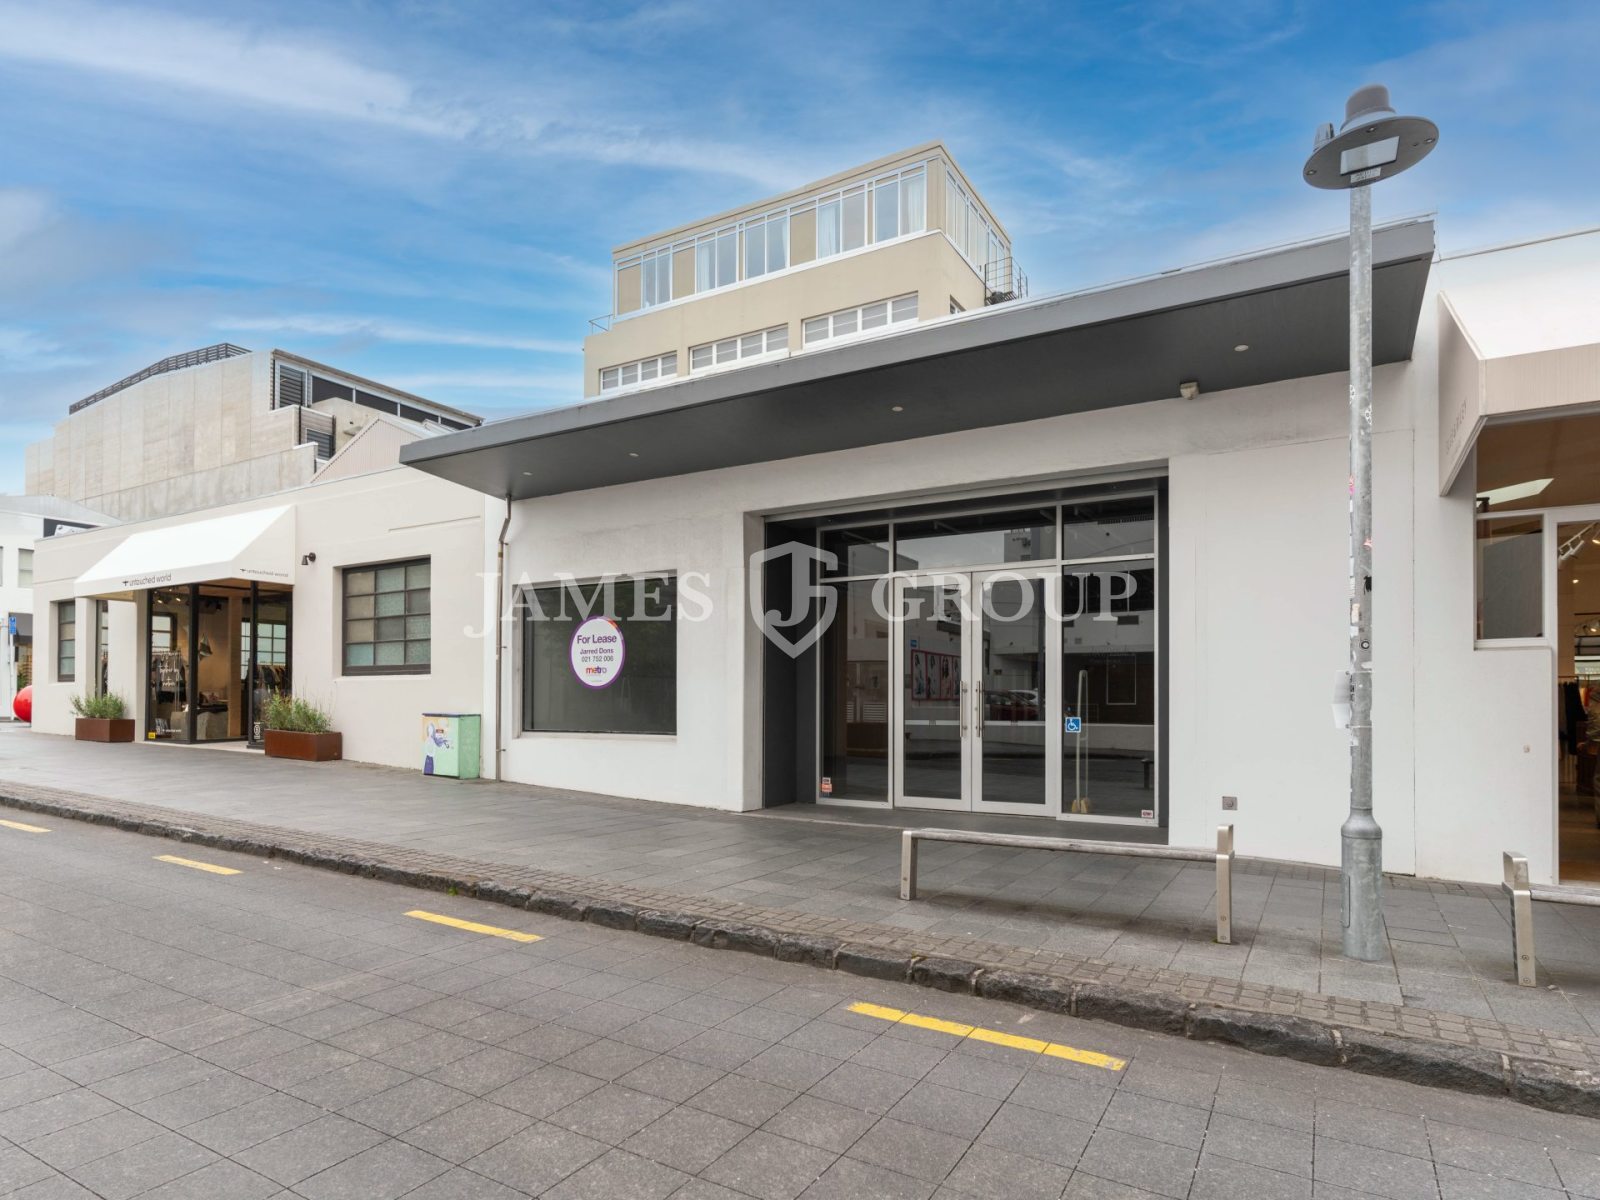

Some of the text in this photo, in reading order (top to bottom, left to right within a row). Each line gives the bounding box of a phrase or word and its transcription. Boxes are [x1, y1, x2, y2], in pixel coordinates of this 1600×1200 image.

[129, 573, 171, 586] untouched world
[576, 634, 617, 644] For Lease
[585, 665, 607, 674] metro
